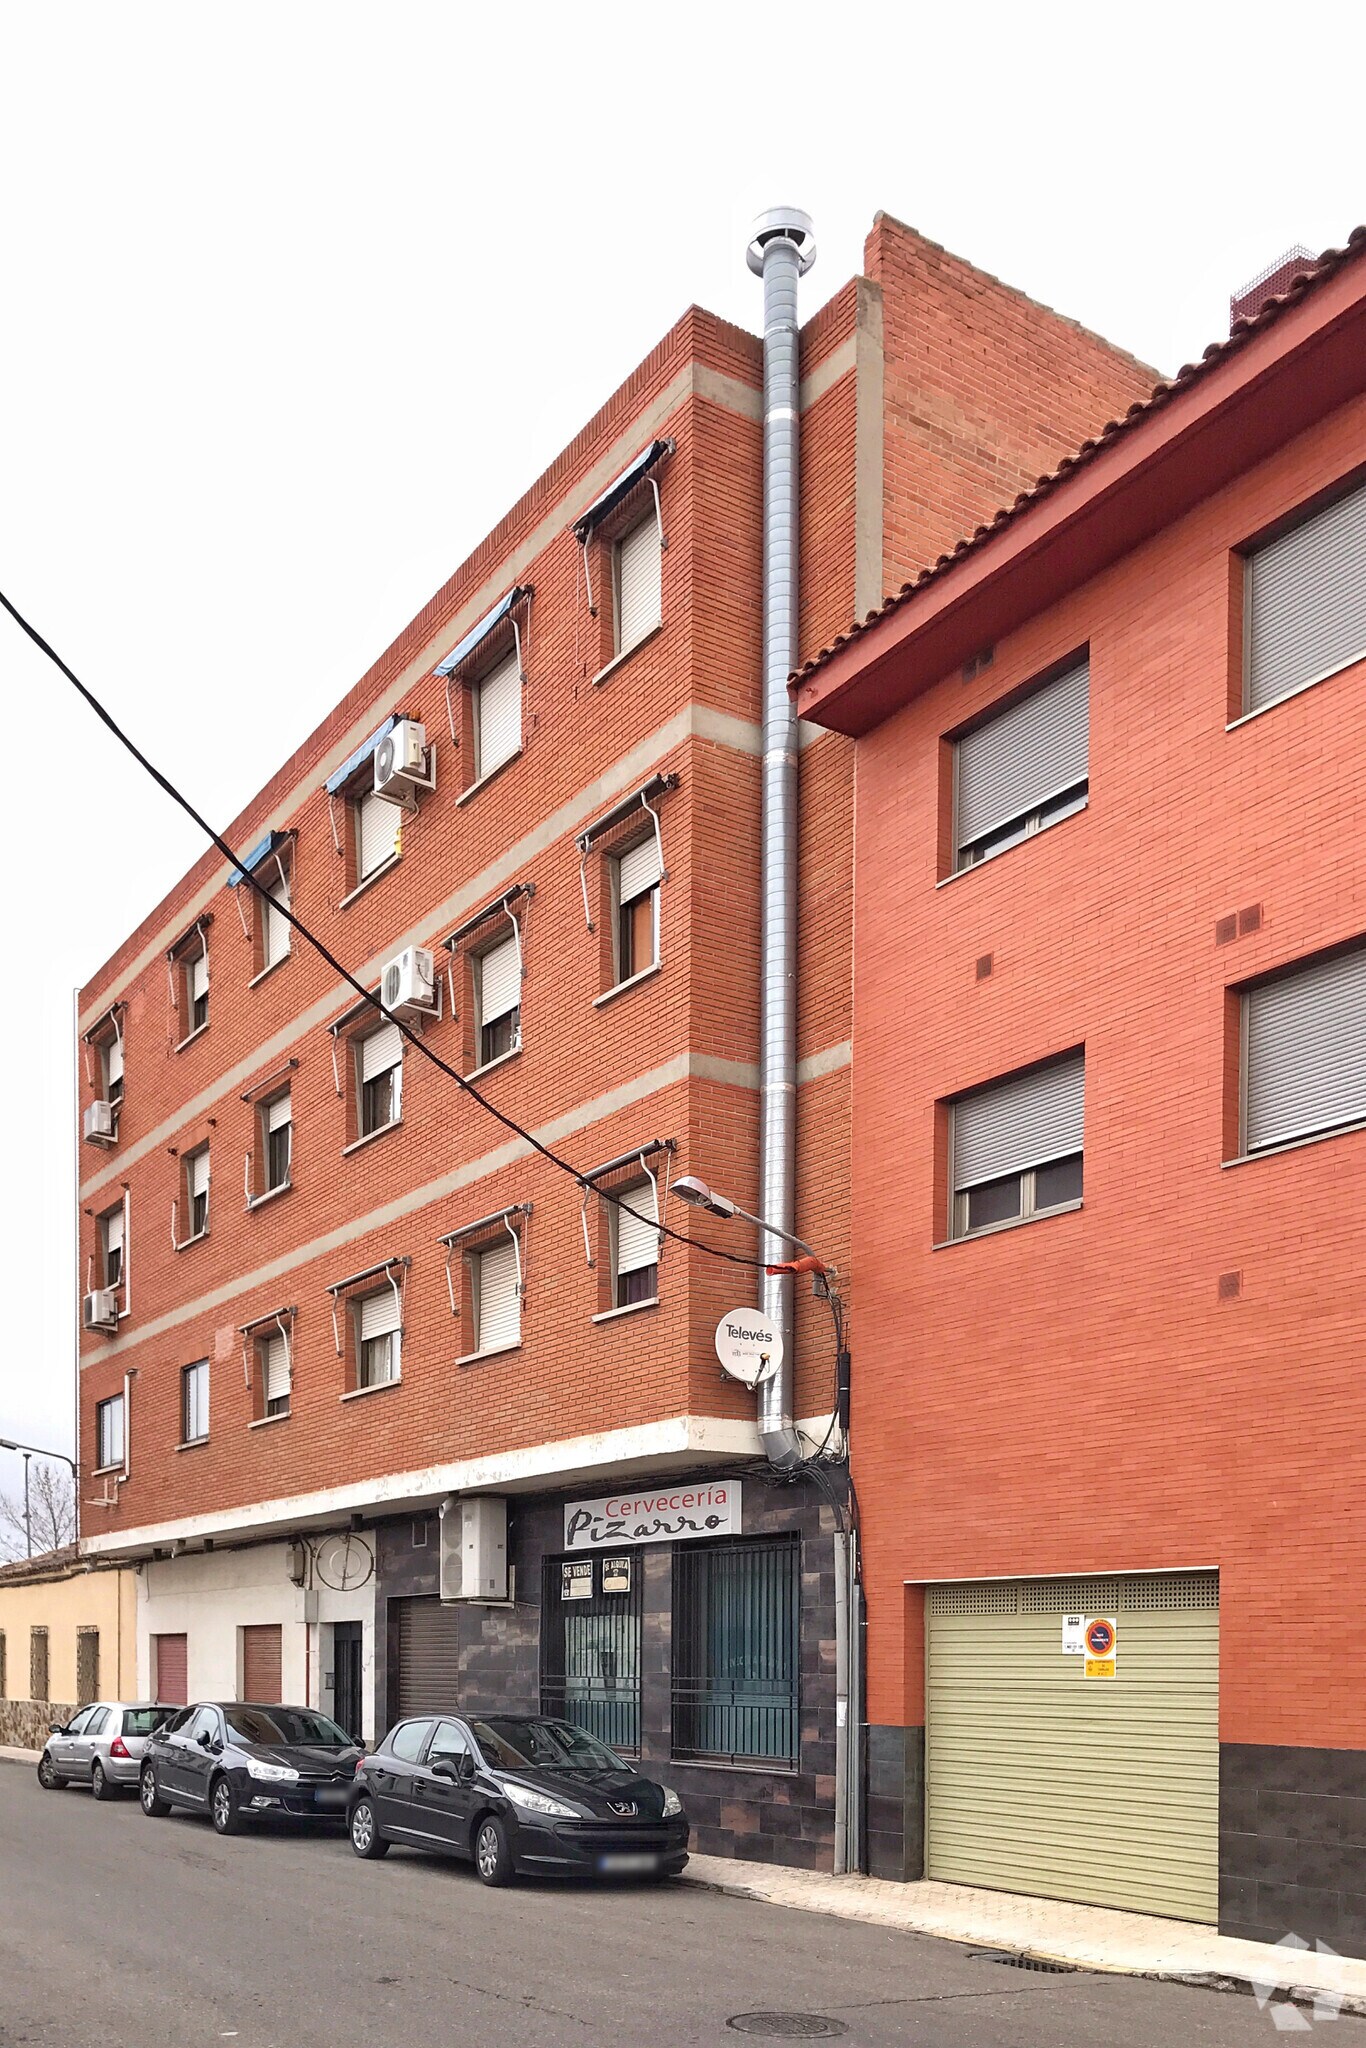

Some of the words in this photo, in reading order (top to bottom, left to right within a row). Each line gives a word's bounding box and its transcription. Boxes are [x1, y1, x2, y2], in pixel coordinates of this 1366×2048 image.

[726, 1324, 773, 1342] Televés
[605, 1486, 727, 1518] Cervecería
[567, 1508, 729, 1546] Pizarro
[563, 1567, 572, 1578] SE
[572, 1564, 591, 1577] VENDE
[610, 1560, 628, 1570] ALQUILA
